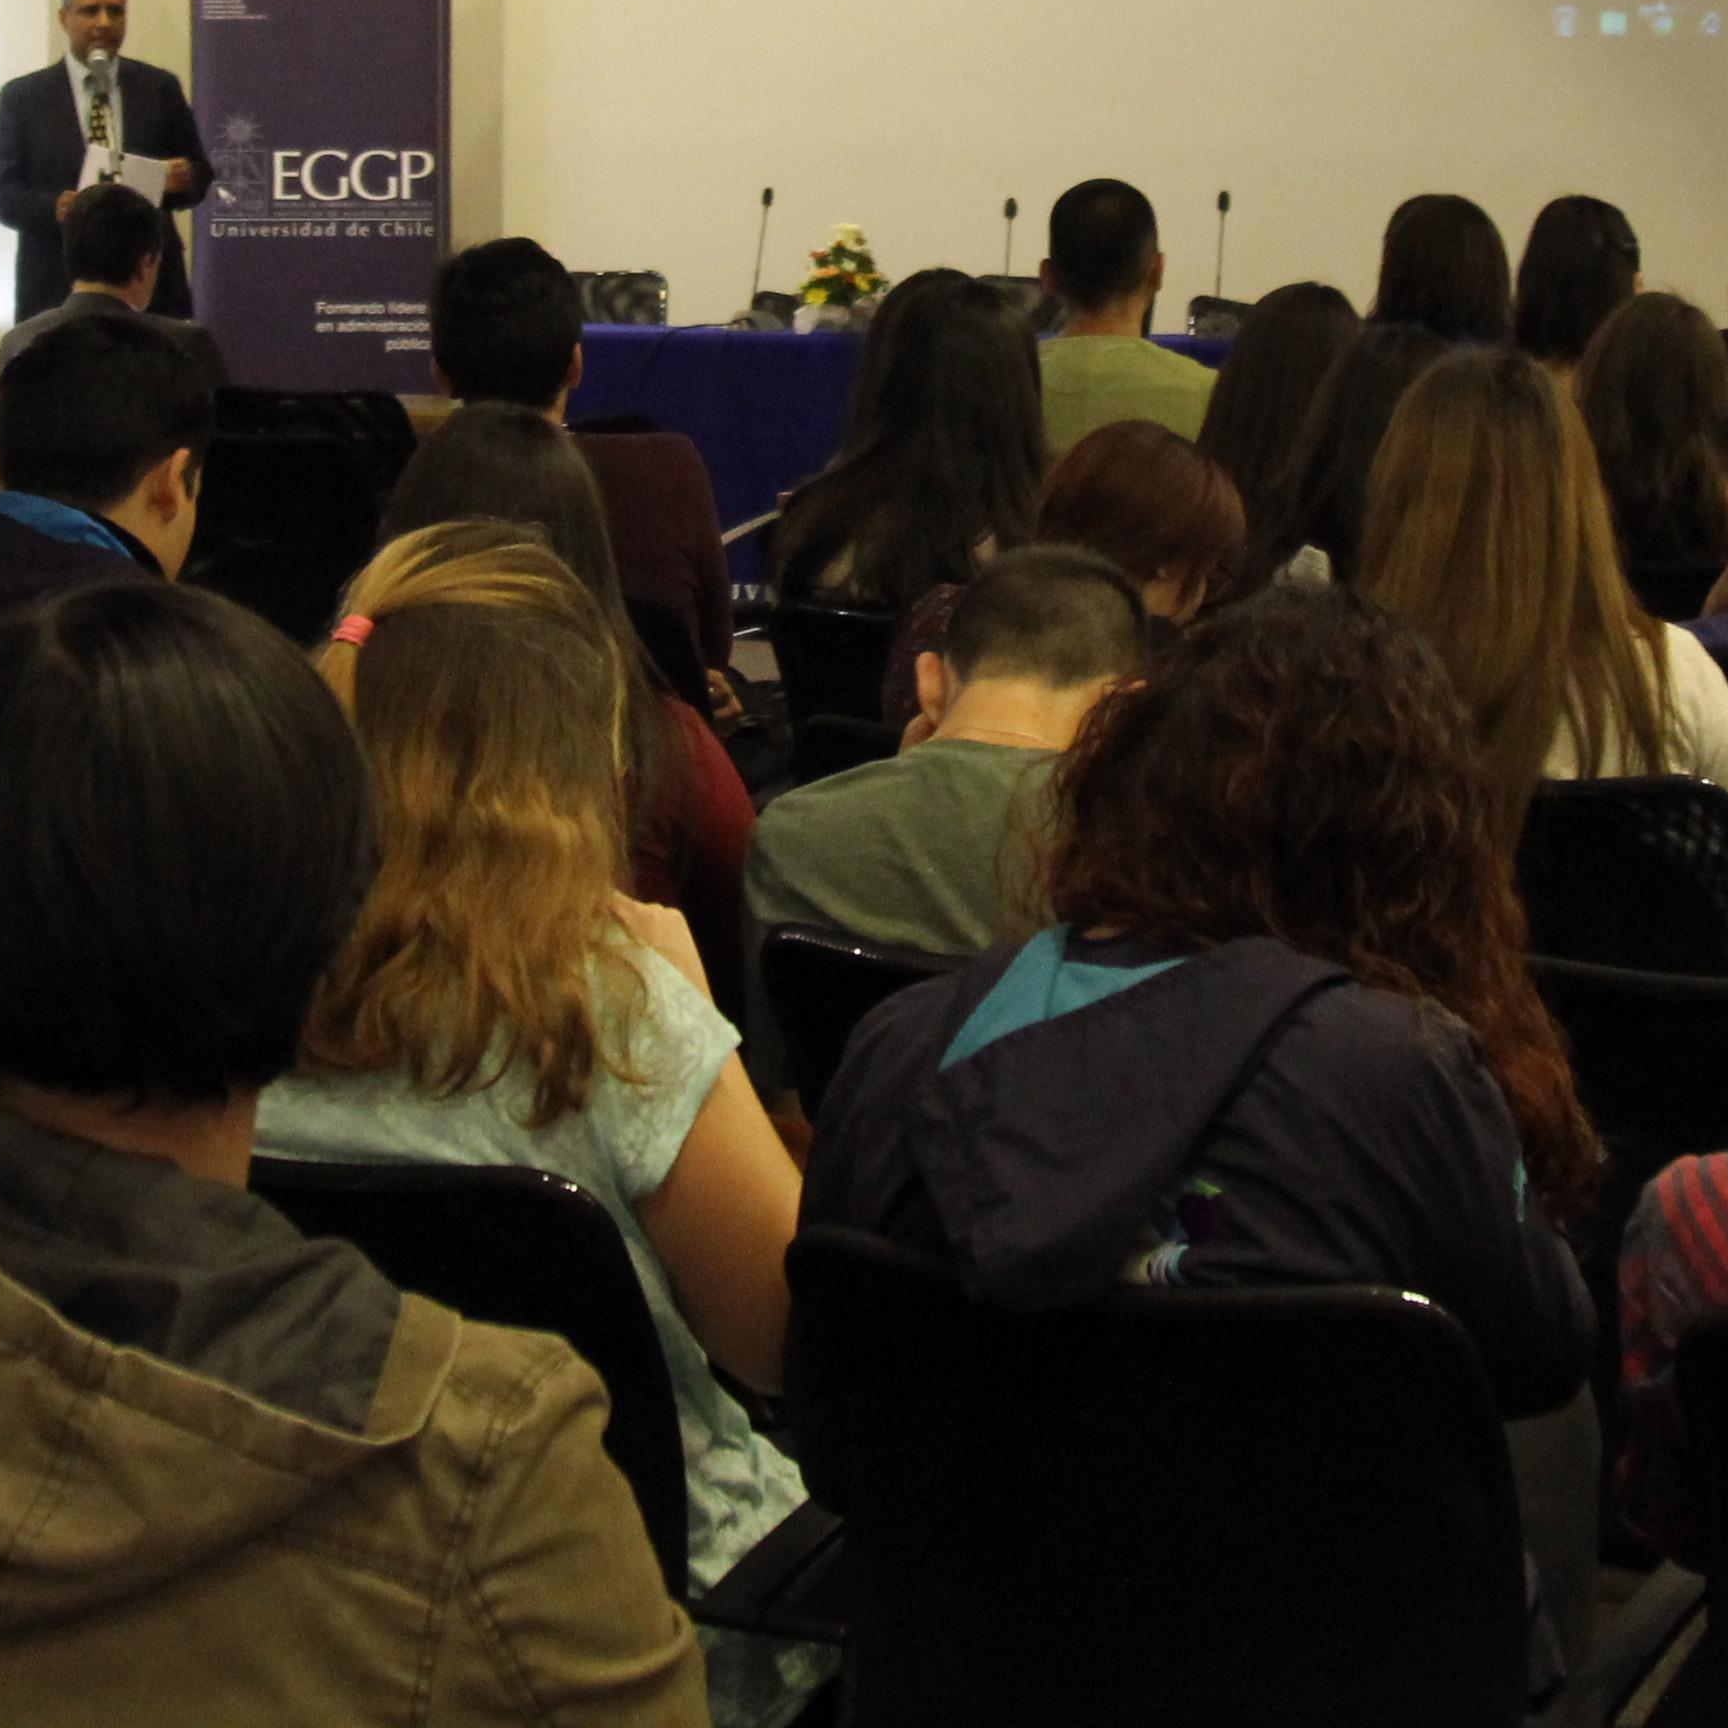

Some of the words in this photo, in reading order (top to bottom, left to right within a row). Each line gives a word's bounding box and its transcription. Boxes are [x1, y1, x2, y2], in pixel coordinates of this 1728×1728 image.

[273, 150, 435, 201] EGGP
[210, 223, 337, 238] Universidad
[345, 223, 370, 238] de
[379, 223, 435, 238] Chile
[387, 302, 428, 314] lídere
